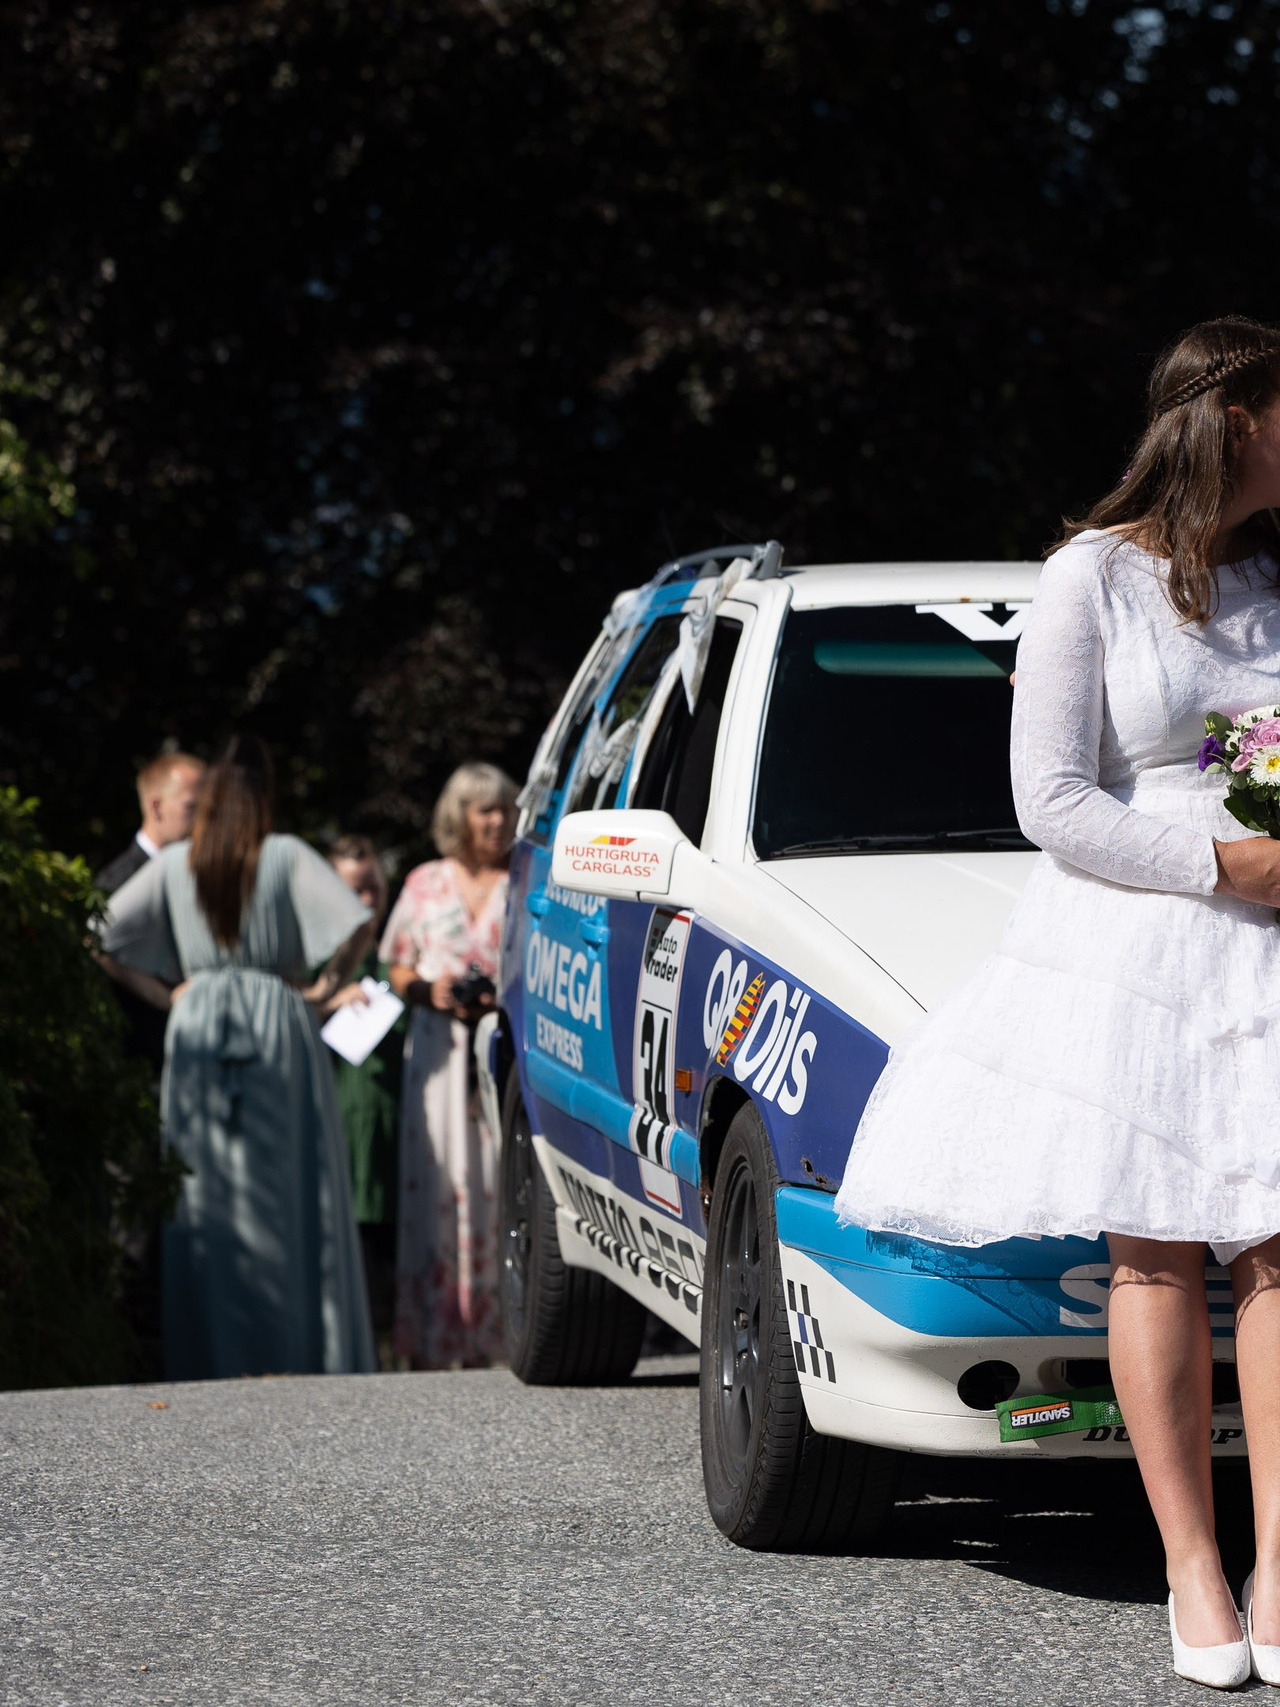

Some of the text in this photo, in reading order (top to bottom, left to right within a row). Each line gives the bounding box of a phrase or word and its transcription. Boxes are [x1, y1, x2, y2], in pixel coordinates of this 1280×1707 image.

[564, 845, 660, 864] HURTIGRUTA
[572, 860, 652, 878] CARGLASS
[657, 931, 678, 954] Auto
[525, 931, 603, 1031] OMEGA
[645, 952, 678, 983] Trader
[536, 1013, 583, 1072] EXPRESS
[733, 979, 818, 1116] Oils
[1011, 1406, 1071, 1427] SANDTLER
